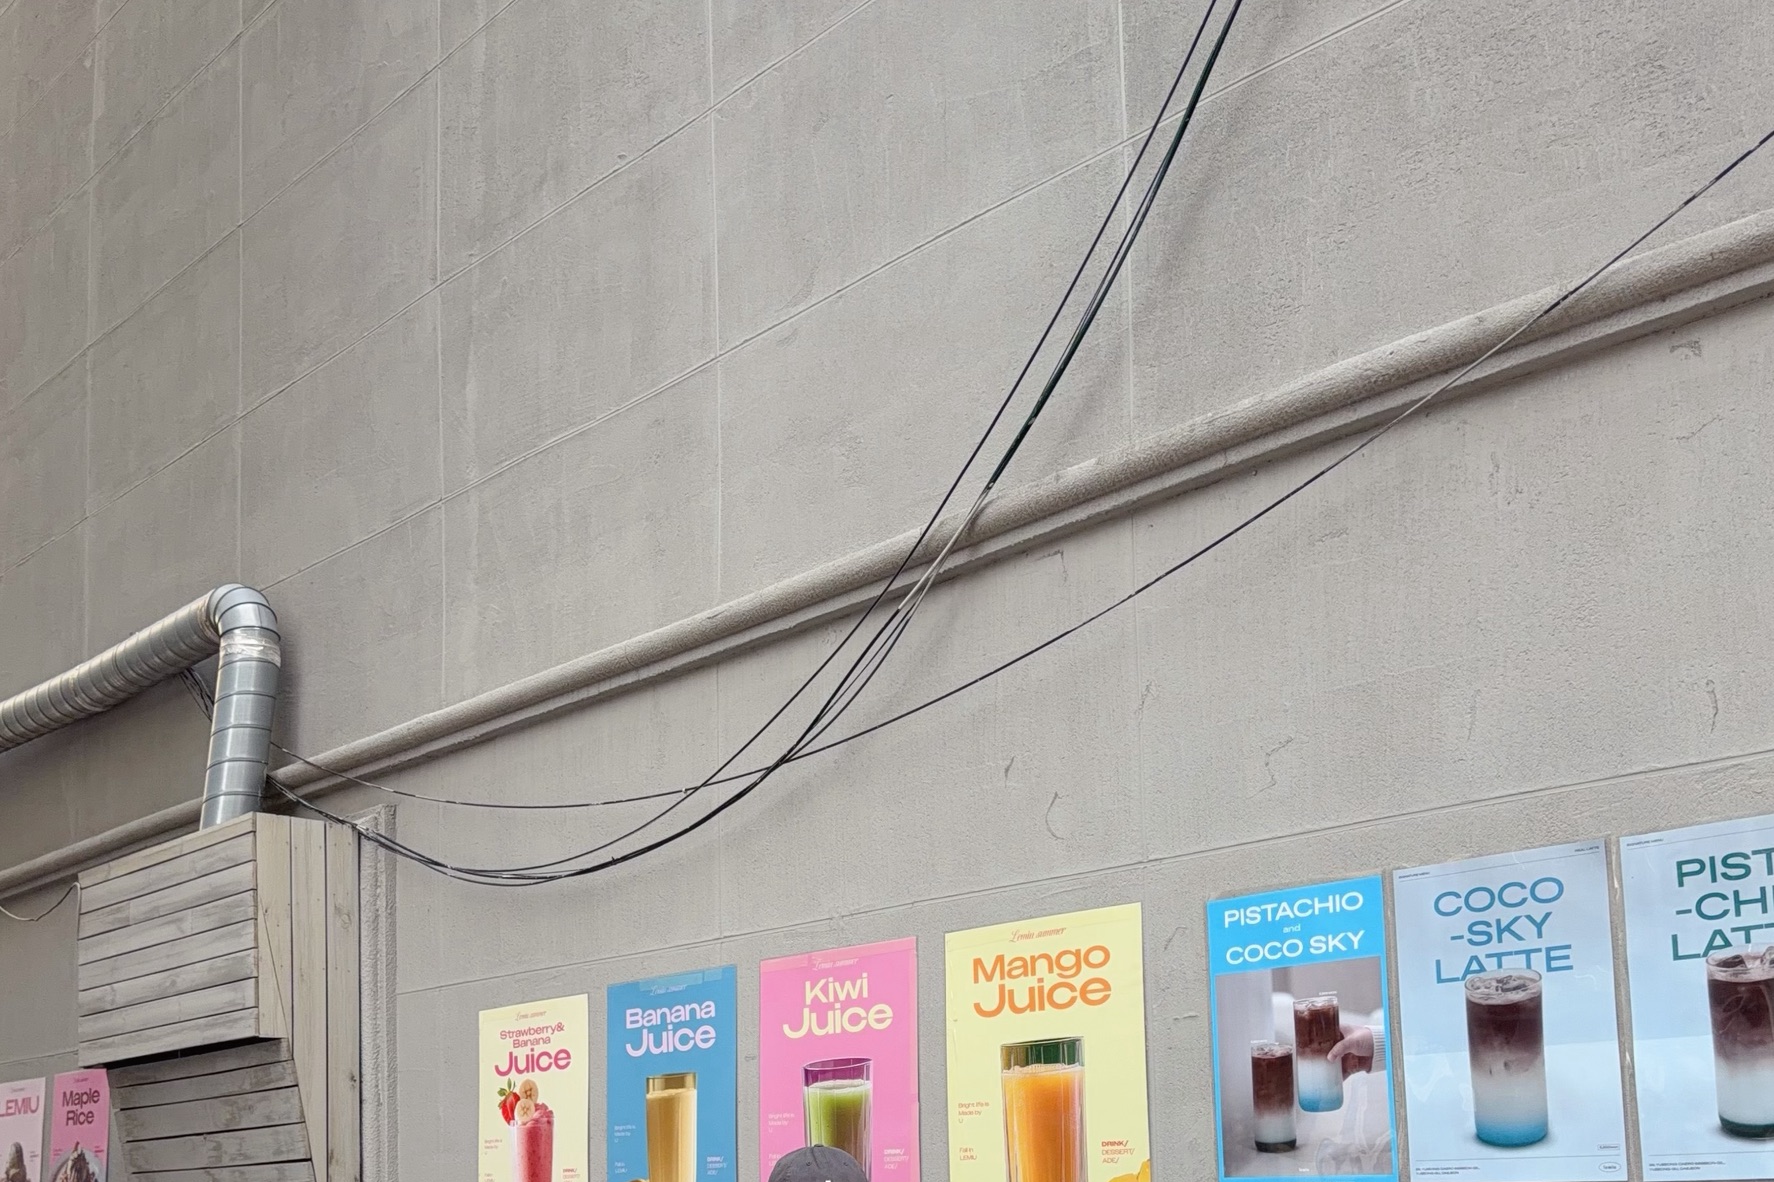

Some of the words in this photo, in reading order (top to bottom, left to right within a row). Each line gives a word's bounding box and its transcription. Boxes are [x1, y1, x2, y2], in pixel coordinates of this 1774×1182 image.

[1676, 847, 1774, 888] PIST
[1224, 891, 1364, 929] PISTACHIO
[1433, 876, 1565, 917] COCO
[1676, 884, 1774, 921] -CH
[1282, 923, 1301, 934] and
[1450, 911, 1553, 947] -SKY
[1671, 922, 1774, 962] LAT
[972, 944, 1111, 985] Mango
[1225, 938, 1304, 965] COCO
[1309, 929, 1366, 955] SKY
[1435, 944, 1574, 984] LATTE
[805, 972, 869, 1005] Kiwi
[973, 976, 1112, 1018] Juice
[499, 1021, 565, 1041] Strawberry&
[625, 1000, 716, 1029] Banana
[782, 1002, 894, 1039] Juice
[512, 1035, 551, 1048] Banana
[625, 1024, 717, 1057] Juice
[494, 1047, 572, 1077] Juice
[62, 1087, 100, 1108] Maple
[66, 1109, 95, 1127] Rice
